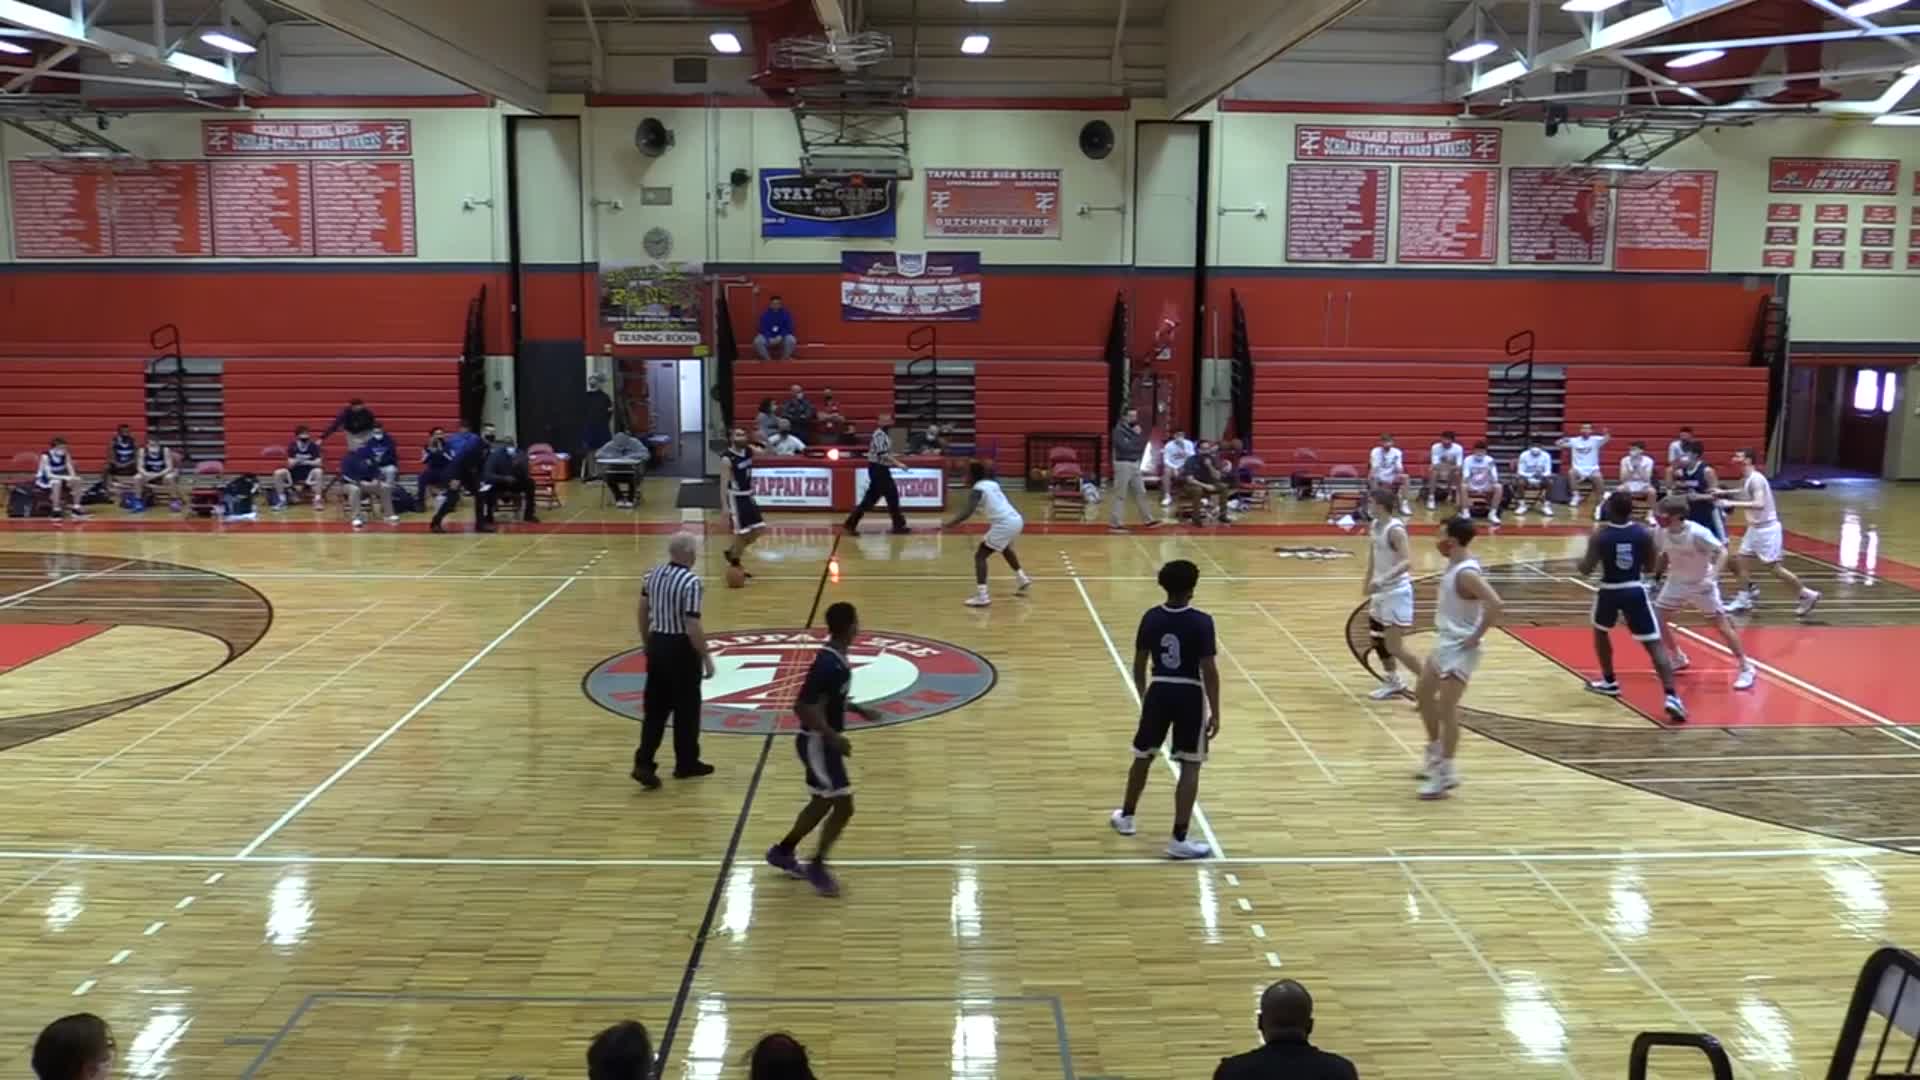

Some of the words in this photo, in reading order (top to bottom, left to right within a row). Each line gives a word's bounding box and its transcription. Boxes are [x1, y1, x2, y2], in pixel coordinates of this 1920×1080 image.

[928, 170, 967, 179] TAPPAN
[970, 170, 989, 179] ZEE
[1020, 170, 1058, 179] SCHOOL
[773, 187, 815, 201] STAY
[936, 217, 1008, 227] DUTCHMEN
[1011, 217, 1049, 227] PRIDE
[619, 334, 664, 342] TRAINING
[666, 334, 697, 342] ROOM
[1616, 543, 1633, 570] 5
[1160, 633, 1181, 669] 3
